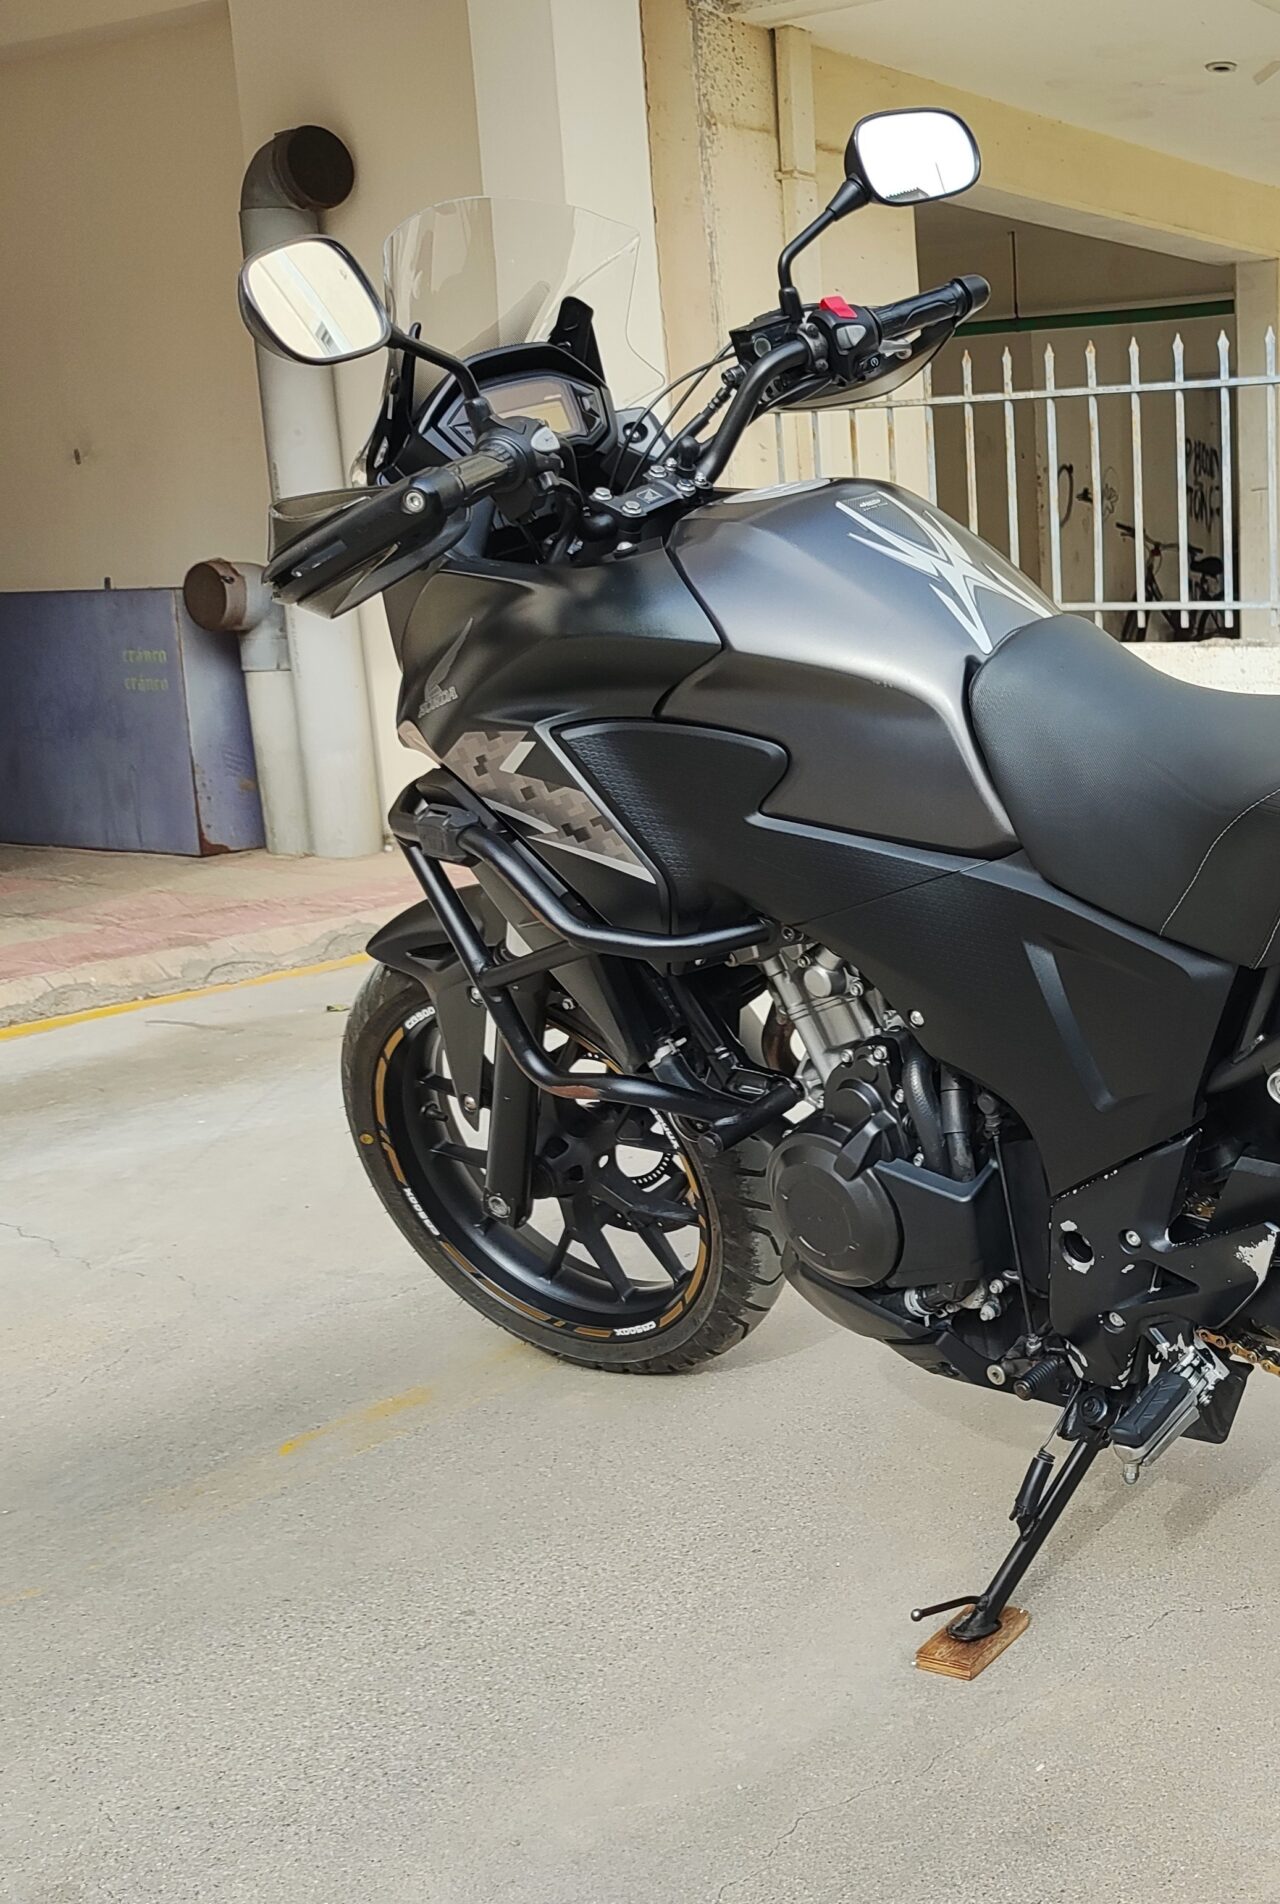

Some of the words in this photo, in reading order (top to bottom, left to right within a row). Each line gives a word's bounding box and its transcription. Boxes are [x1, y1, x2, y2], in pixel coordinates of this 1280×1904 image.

[418, 686, 459, 719] HONDA
[404, 1005, 436, 1030] CB500
[613, 1320, 657, 1336] CB500X
